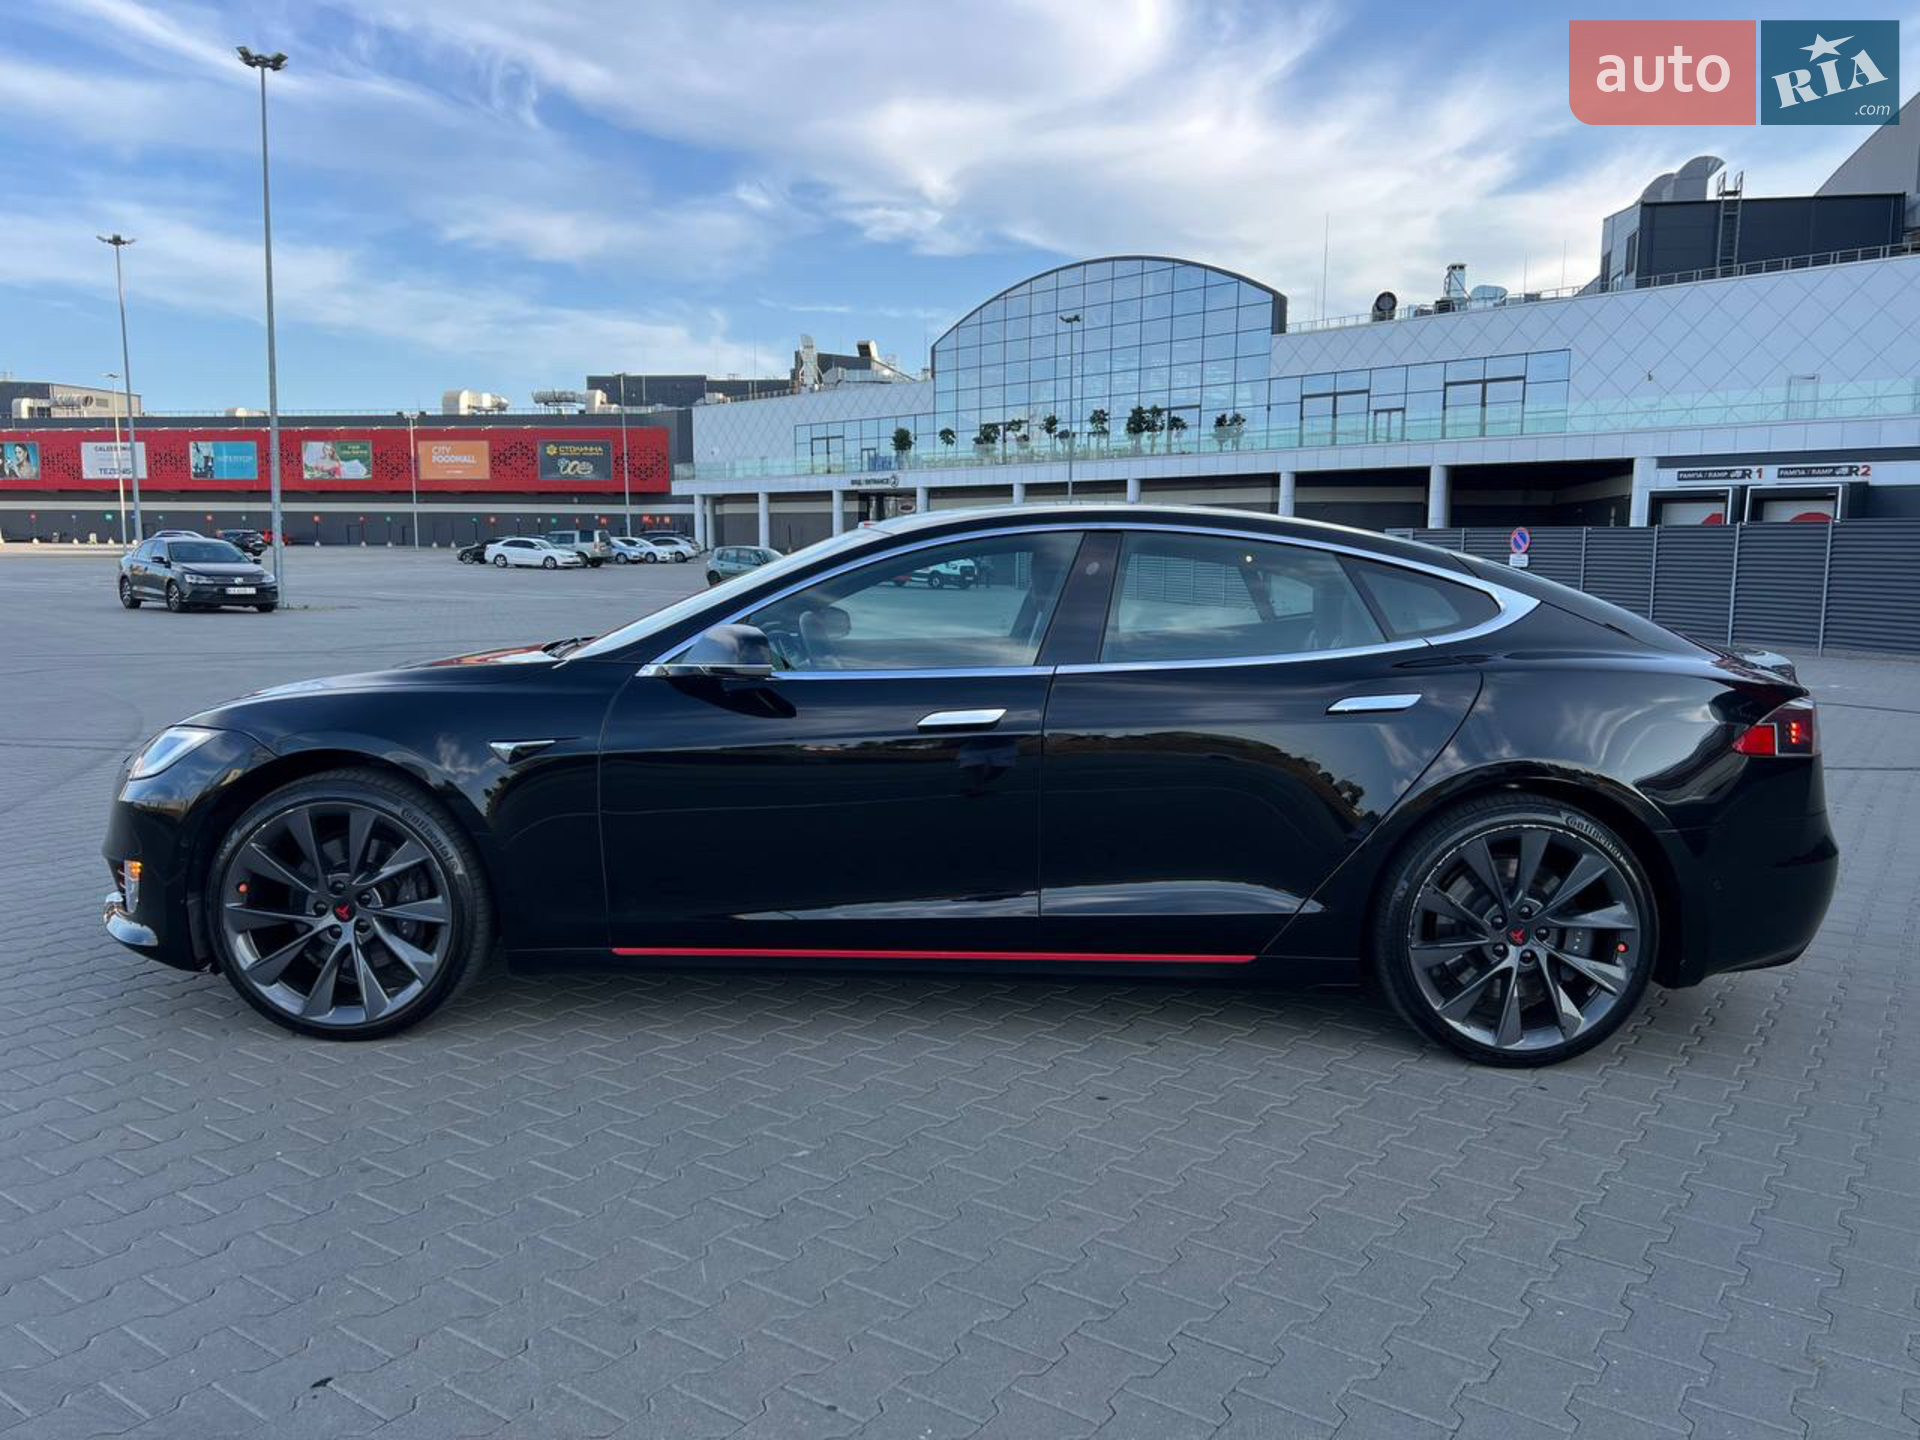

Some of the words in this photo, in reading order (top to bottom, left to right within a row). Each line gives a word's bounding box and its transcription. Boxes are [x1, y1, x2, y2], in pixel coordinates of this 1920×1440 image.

[432, 445, 451, 455] CITY
[432, 455, 477, 464] FOODHALL
[401, 809, 455, 862] Continental
